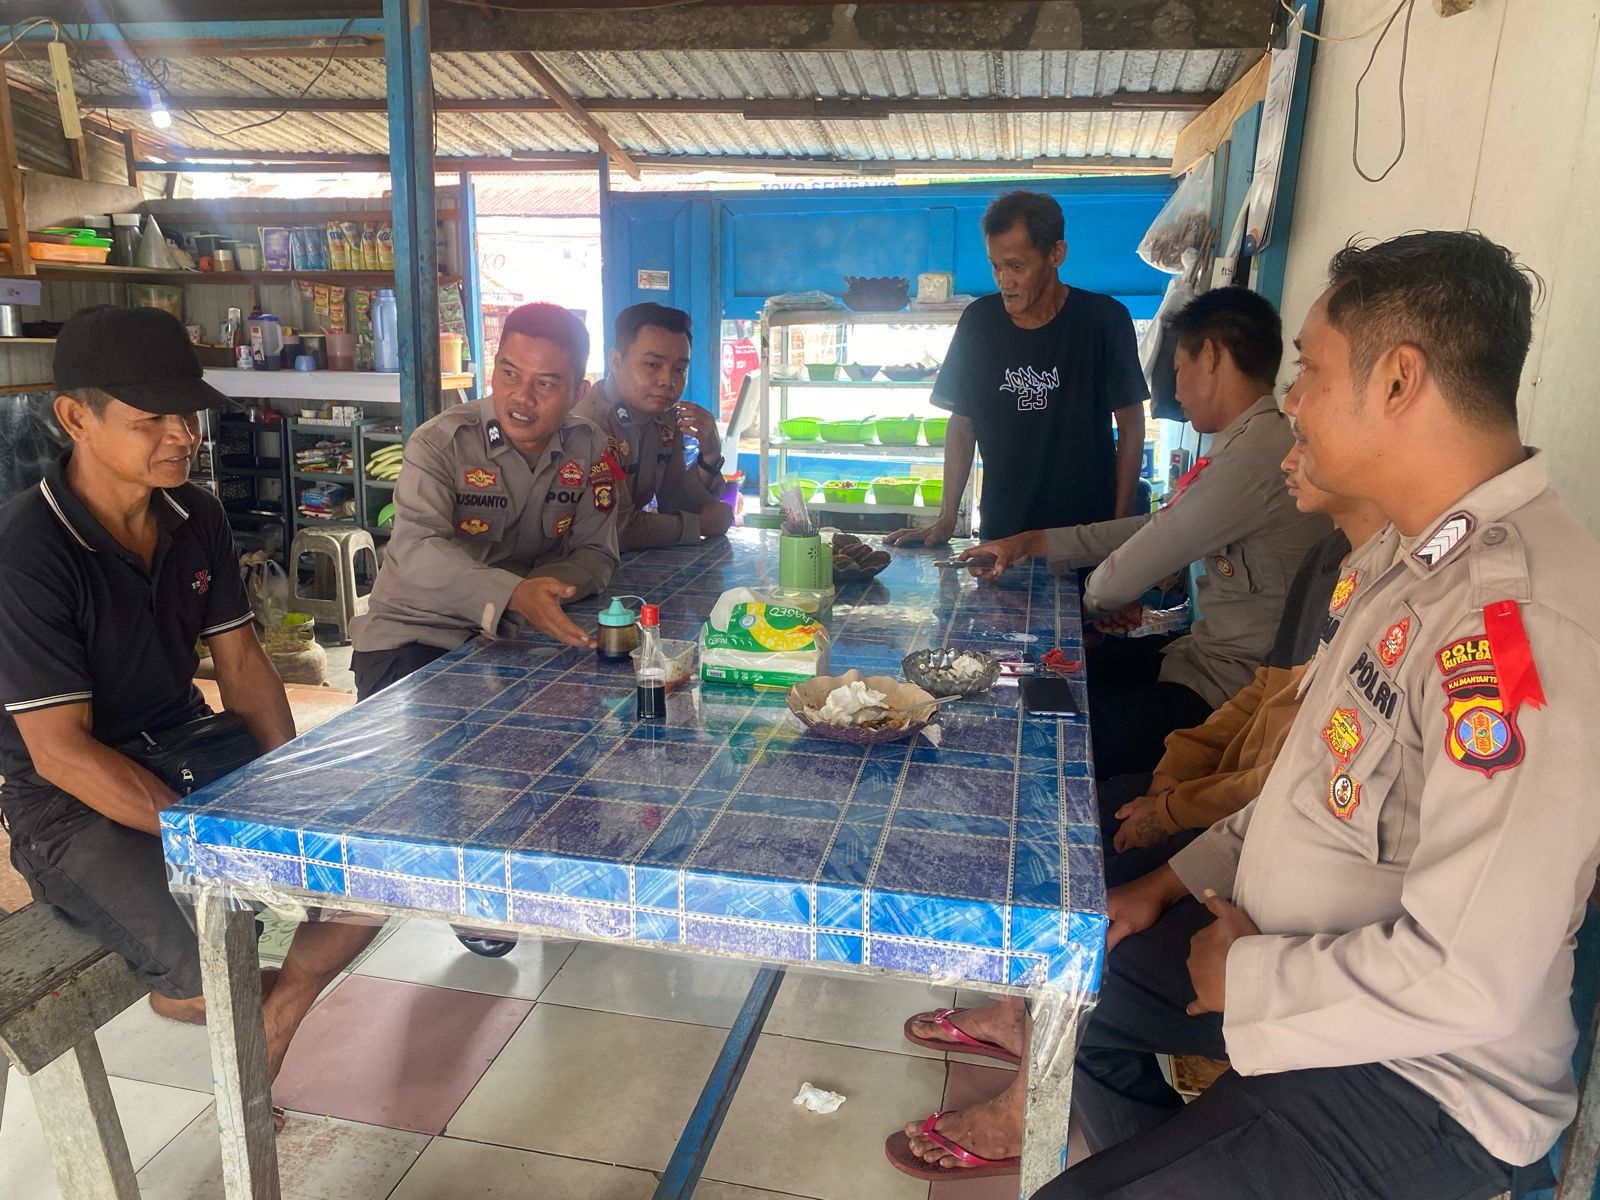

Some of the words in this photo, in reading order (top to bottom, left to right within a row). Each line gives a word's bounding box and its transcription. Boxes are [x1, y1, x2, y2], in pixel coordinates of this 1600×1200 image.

[999, 365, 1060, 393] JORDAN
[1018, 388, 1047, 410] 23
[455, 491, 508, 509] USDIANTO
[545, 491, 584, 504] POL
[1441, 639, 1490, 662] POLR
[1443, 653, 1472, 670] KUTAI
[1475, 651, 1491, 661] BA
[1350, 651, 1397, 720] POLRI
